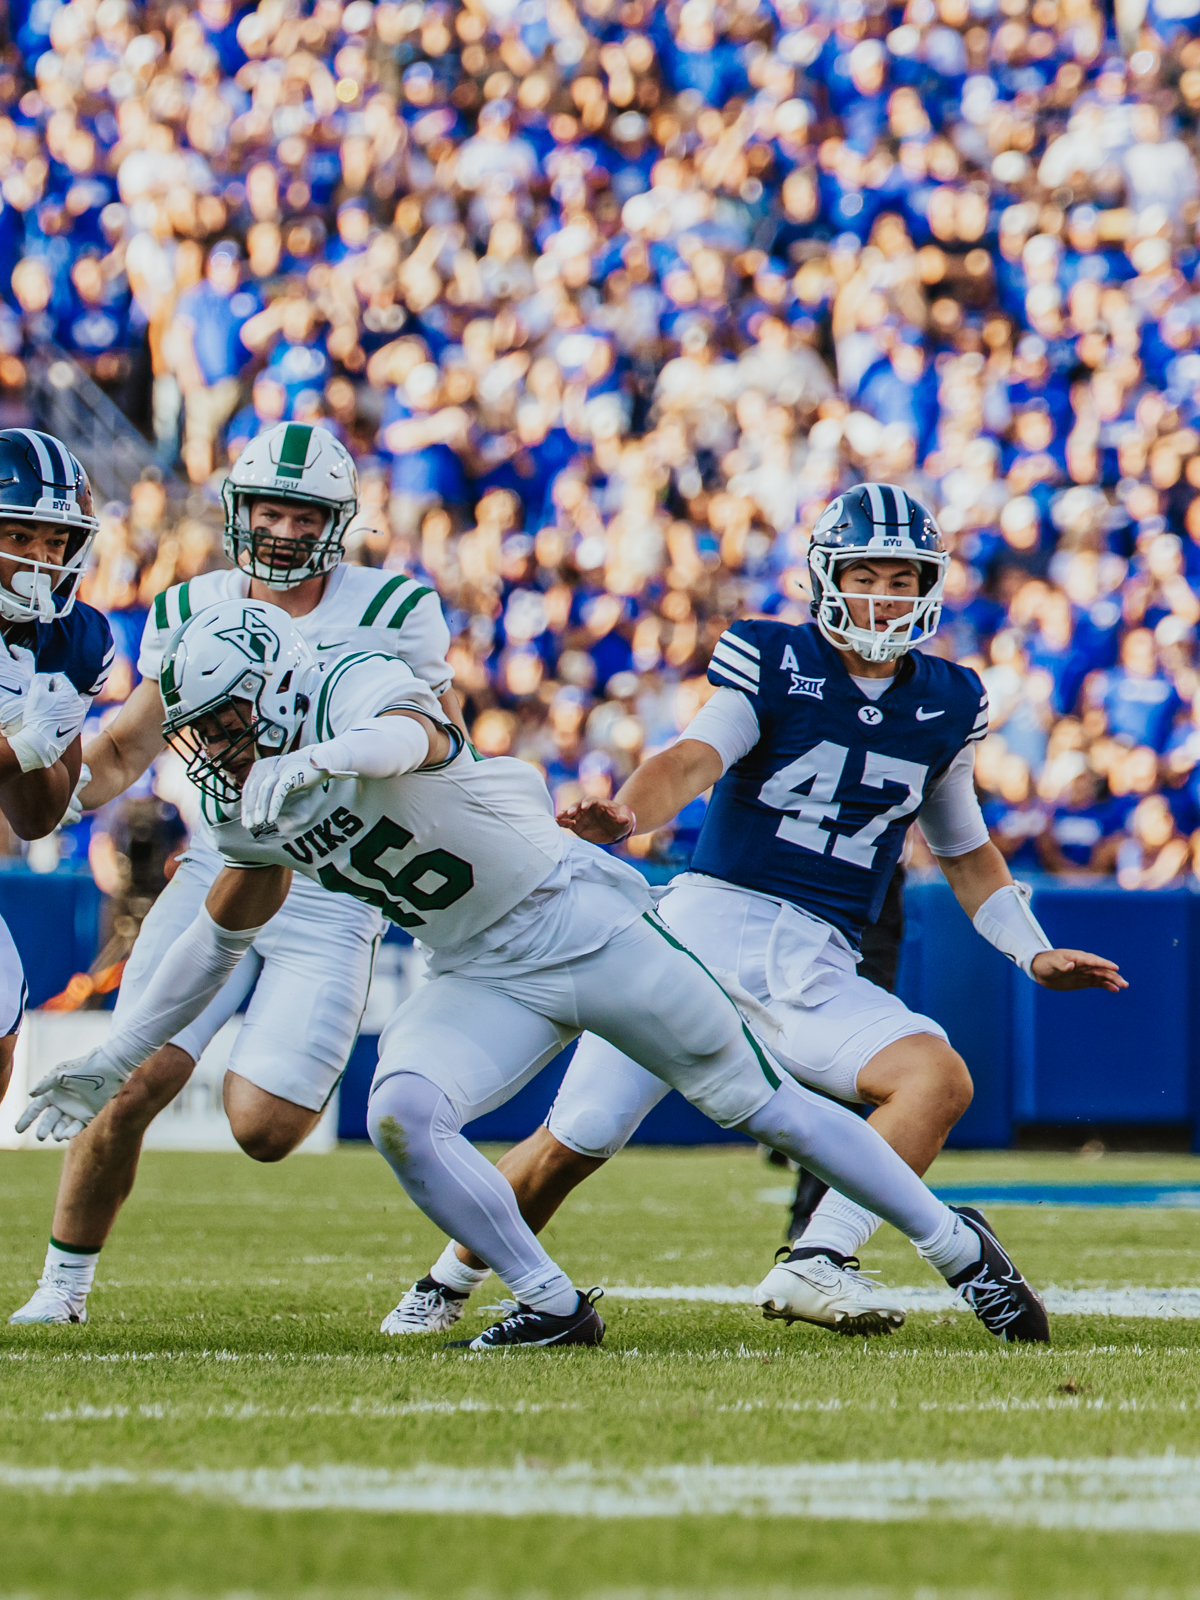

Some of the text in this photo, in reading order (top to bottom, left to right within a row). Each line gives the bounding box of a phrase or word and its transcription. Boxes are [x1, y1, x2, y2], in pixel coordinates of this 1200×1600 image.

[273, 479, 299, 489] PSU
[52, 500, 71, 511] BYU
[883, 538, 903, 547] BYU
[779, 644, 799, 672] A
[168, 707, 182, 719] PSU
[862, 708, 880, 722] Y
[758, 740, 929, 870] 47
[282, 806, 365, 864] VIKS
